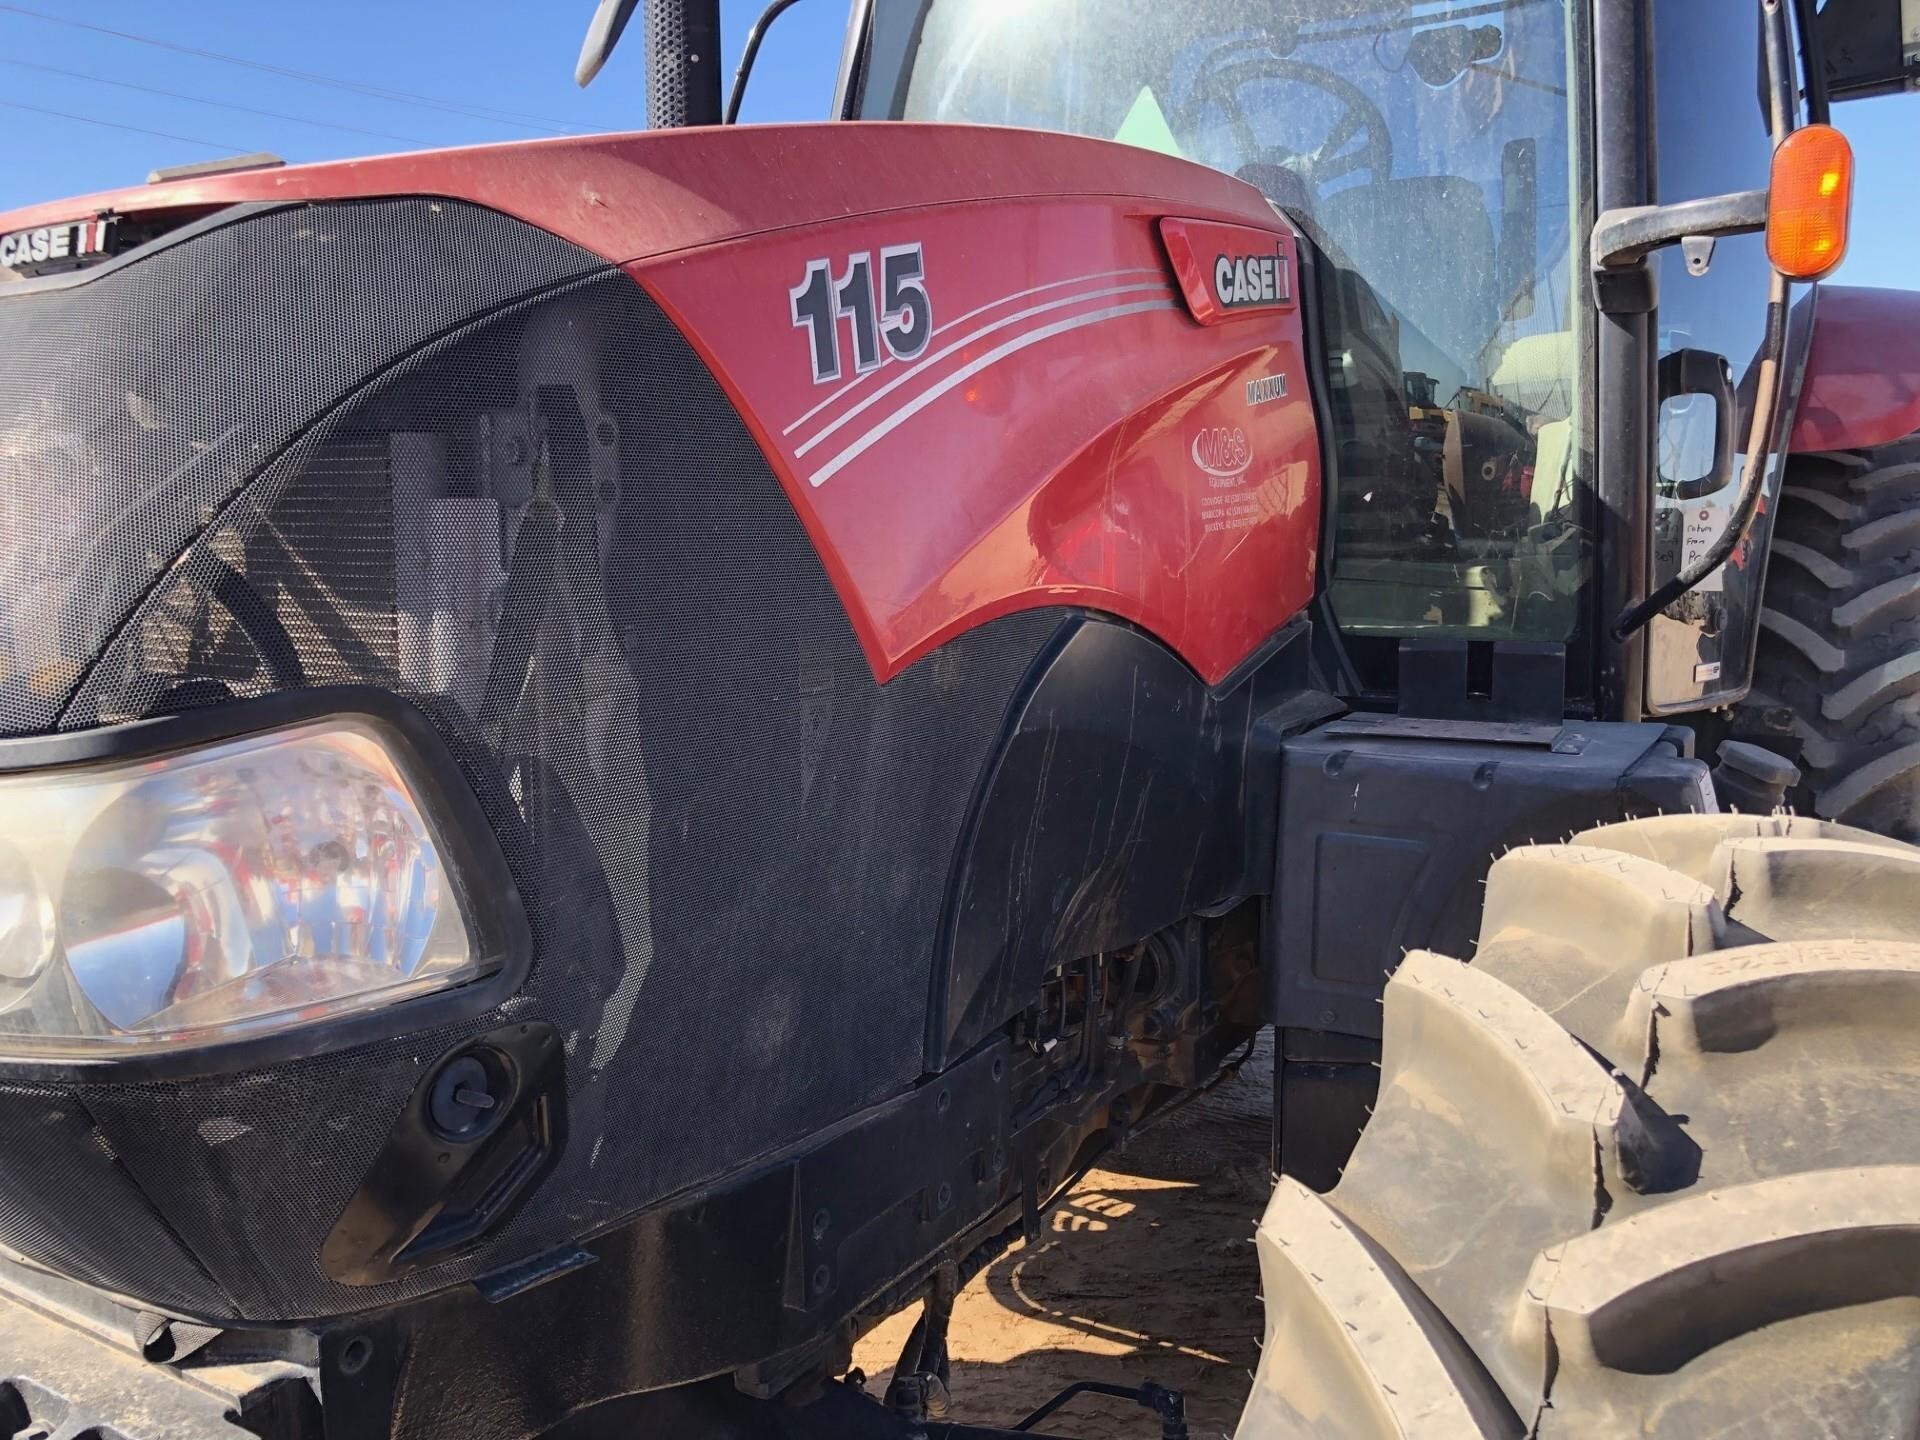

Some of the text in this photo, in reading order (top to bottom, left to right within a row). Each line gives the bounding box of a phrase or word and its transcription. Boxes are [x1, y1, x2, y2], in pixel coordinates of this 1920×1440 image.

[0, 226, 70, 267] CASE
[1215, 255, 1274, 305] CASE
[789, 240, 932, 384] 115
[1247, 373, 1288, 406] MAXXUM
[1201, 427, 1246, 467] M&S
